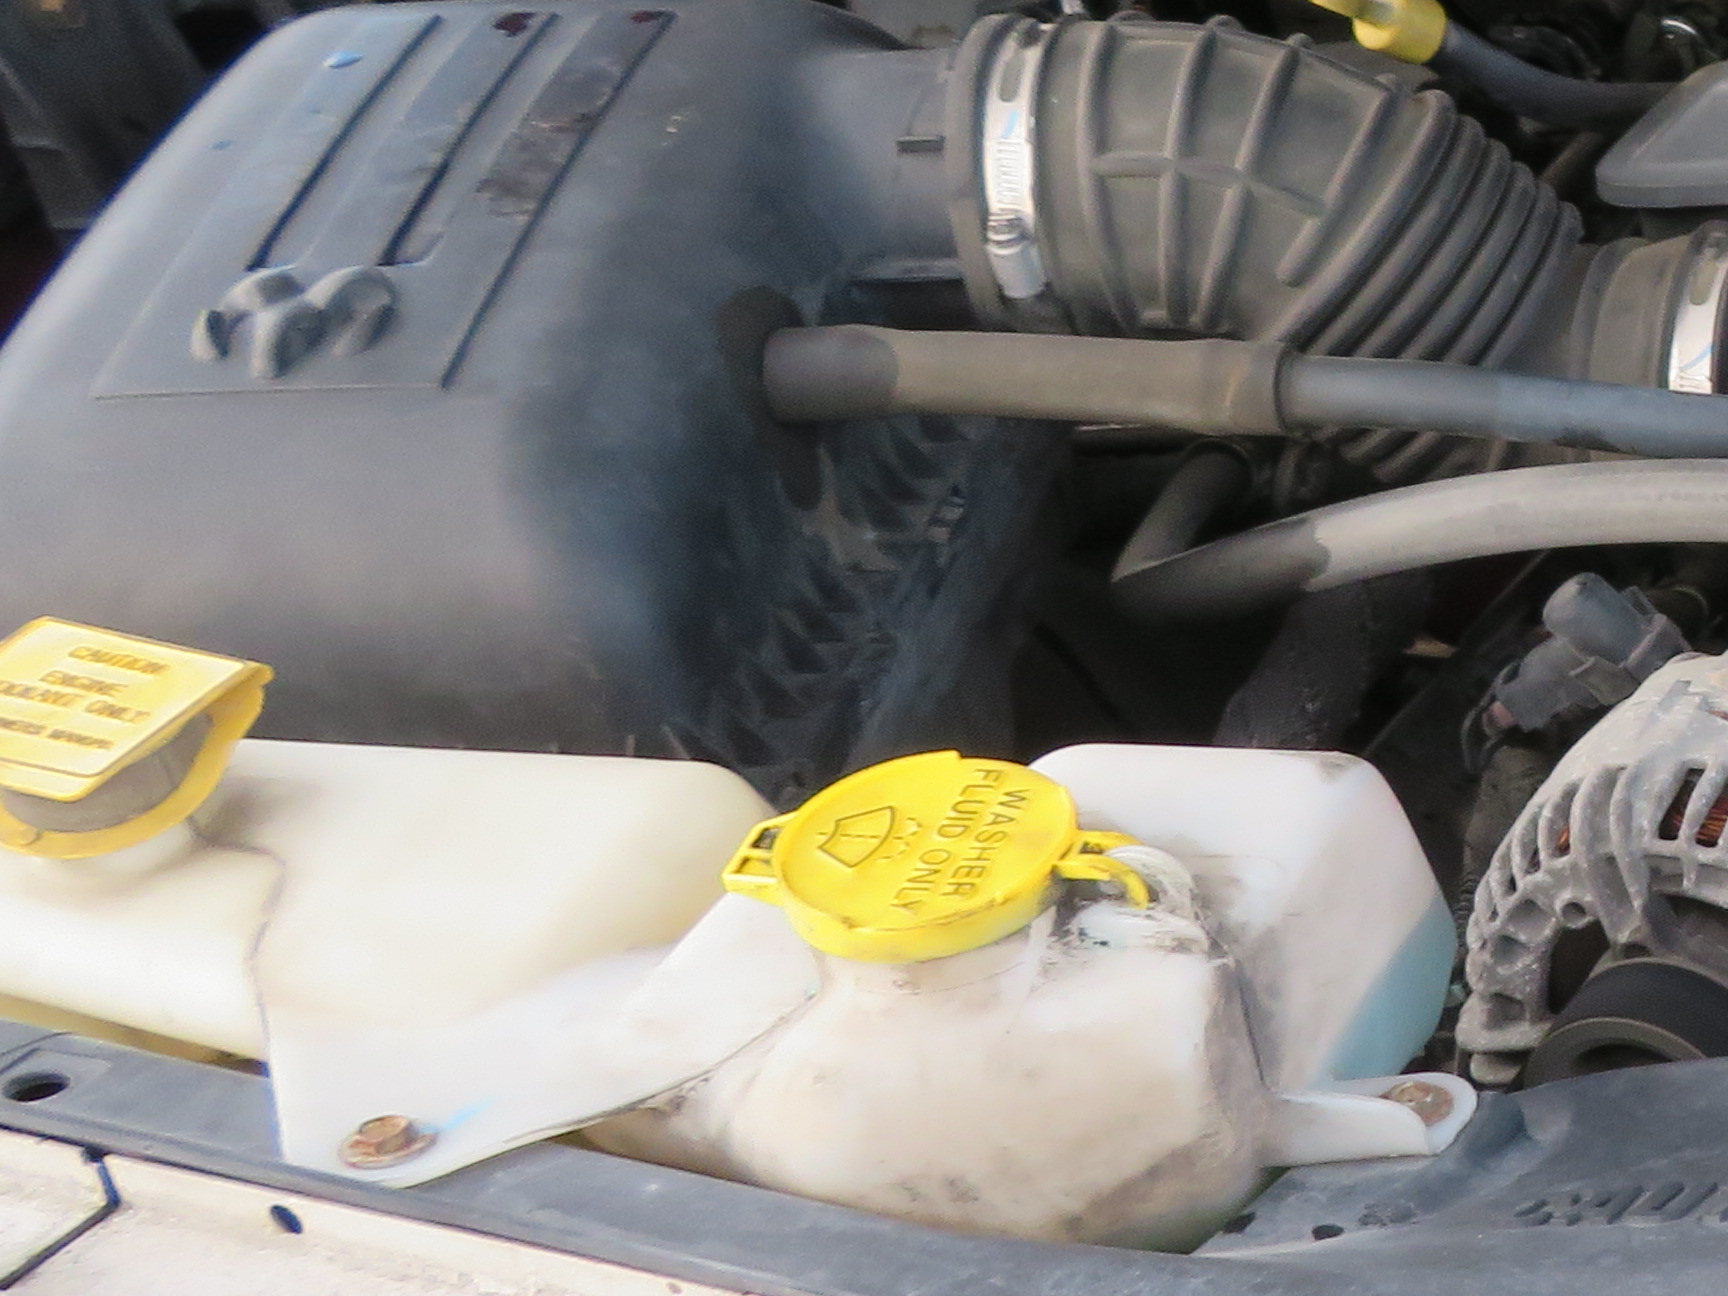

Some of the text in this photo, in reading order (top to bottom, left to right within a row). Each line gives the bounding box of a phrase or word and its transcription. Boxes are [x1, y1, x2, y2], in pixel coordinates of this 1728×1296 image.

[891, 767, 1003, 914] FLUID ONLY
[941, 787, 1033, 898] WASHER
